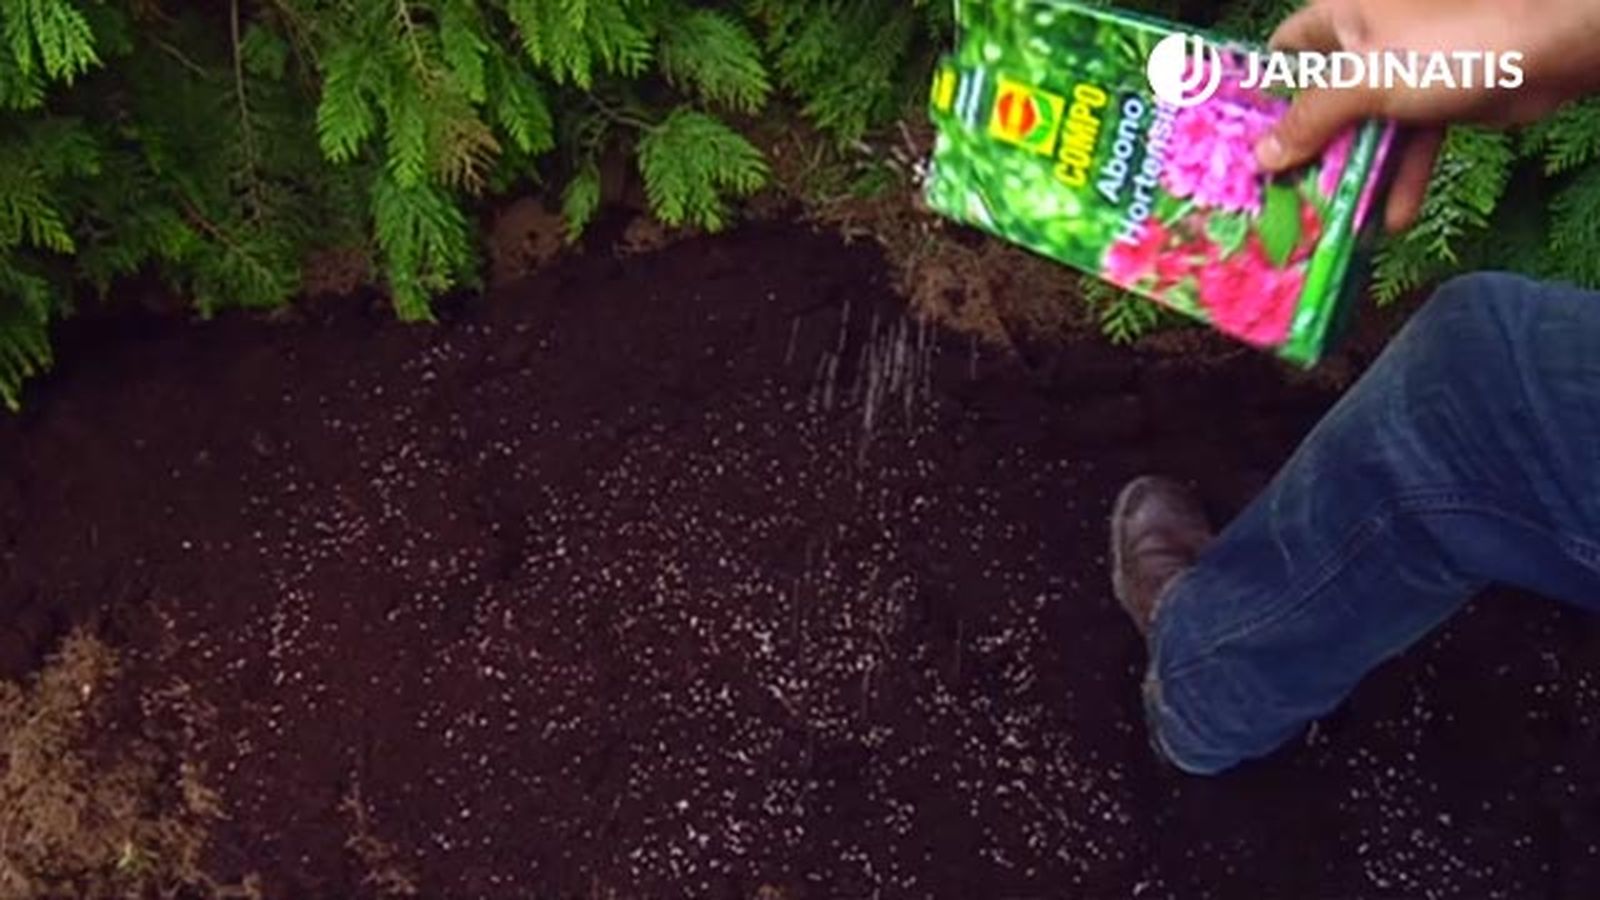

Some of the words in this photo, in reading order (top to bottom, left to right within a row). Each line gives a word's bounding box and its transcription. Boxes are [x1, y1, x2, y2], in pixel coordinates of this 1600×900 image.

[1055, 84, 1107, 187] COMPO
[1097, 98, 1143, 202] Abono
[1117, 100, 1178, 245] Hortensi
